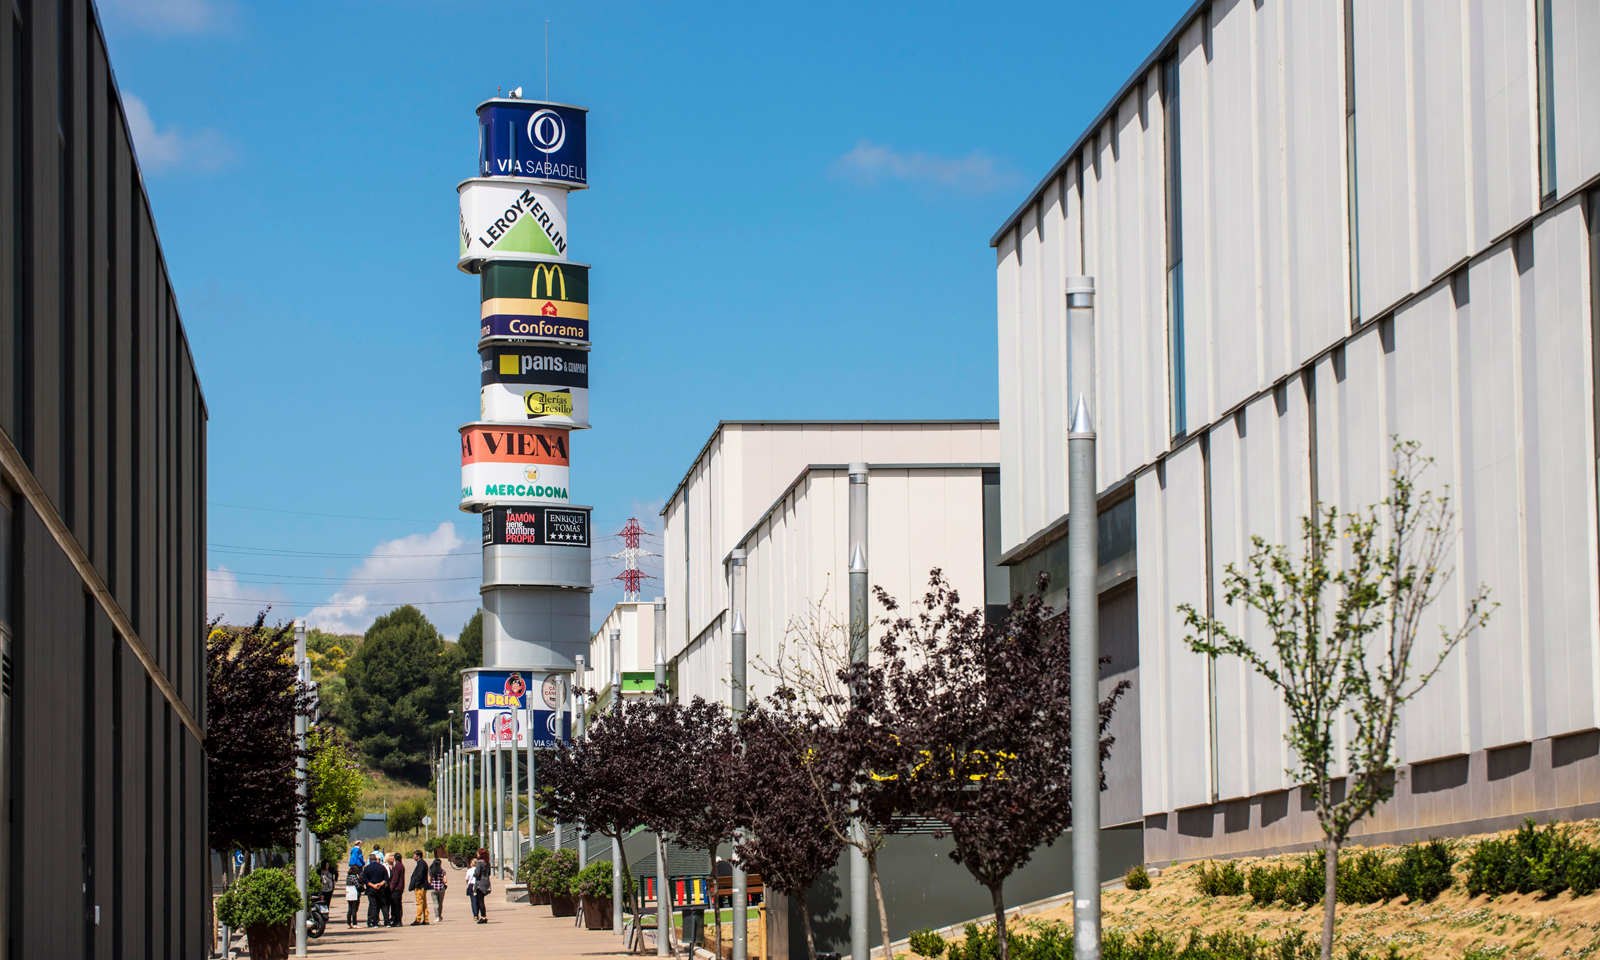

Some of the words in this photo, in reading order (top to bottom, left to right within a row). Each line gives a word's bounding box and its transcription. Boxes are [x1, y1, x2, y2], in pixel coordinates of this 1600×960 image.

[497, 158, 523, 173] VIA
[525, 160, 586, 181] SABADELL
[479, 199, 525, 249] LEROY
[519, 189, 567, 254] MERLIN
[509, 319, 584, 338] Conforama
[521, 355, 564, 374] pans
[563, 361, 568, 372] &
[568, 362, 587, 375] COMPANY
[481, 432, 568, 459] VIENA
[485, 484, 568, 500] MERCADONA
[506, 512, 535, 523] JAMÓN
[550, 514, 583, 525] ENRIQUE
[506, 526, 535, 535] nombre
[506, 534, 535, 543] PROPIO
[533, 739, 545, 747] VIA
